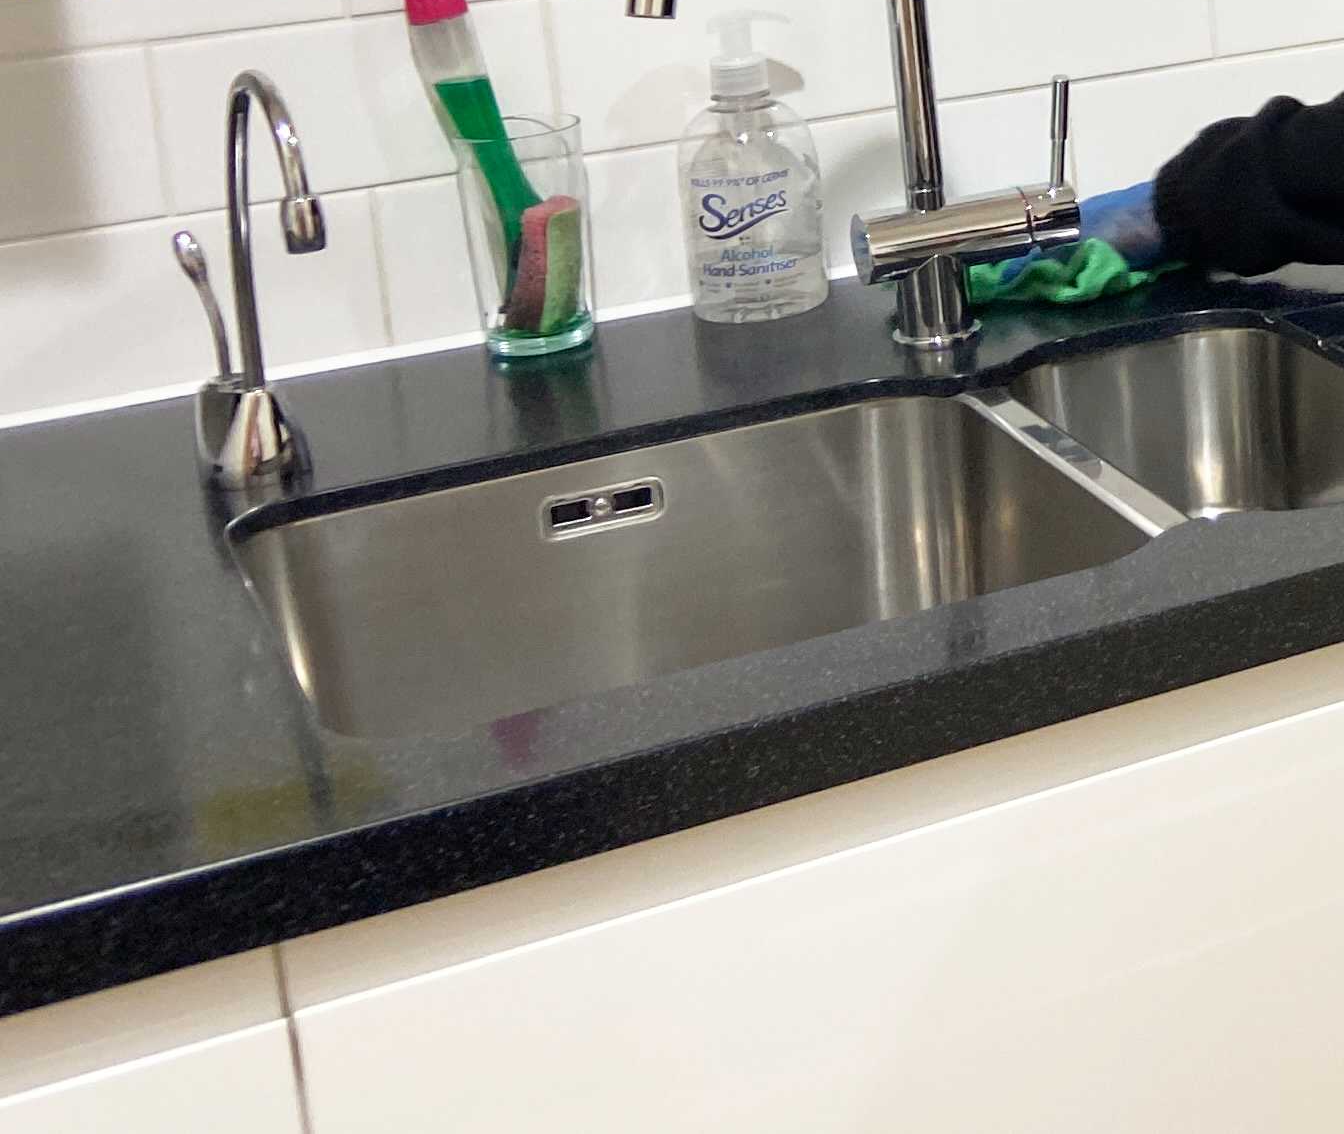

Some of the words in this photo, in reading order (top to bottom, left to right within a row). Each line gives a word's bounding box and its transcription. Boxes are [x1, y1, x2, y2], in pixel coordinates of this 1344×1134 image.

[698, 189, 787, 233] Senses
[721, 245, 774, 262] Alcohol
[703, 262, 736, 278] Hand
